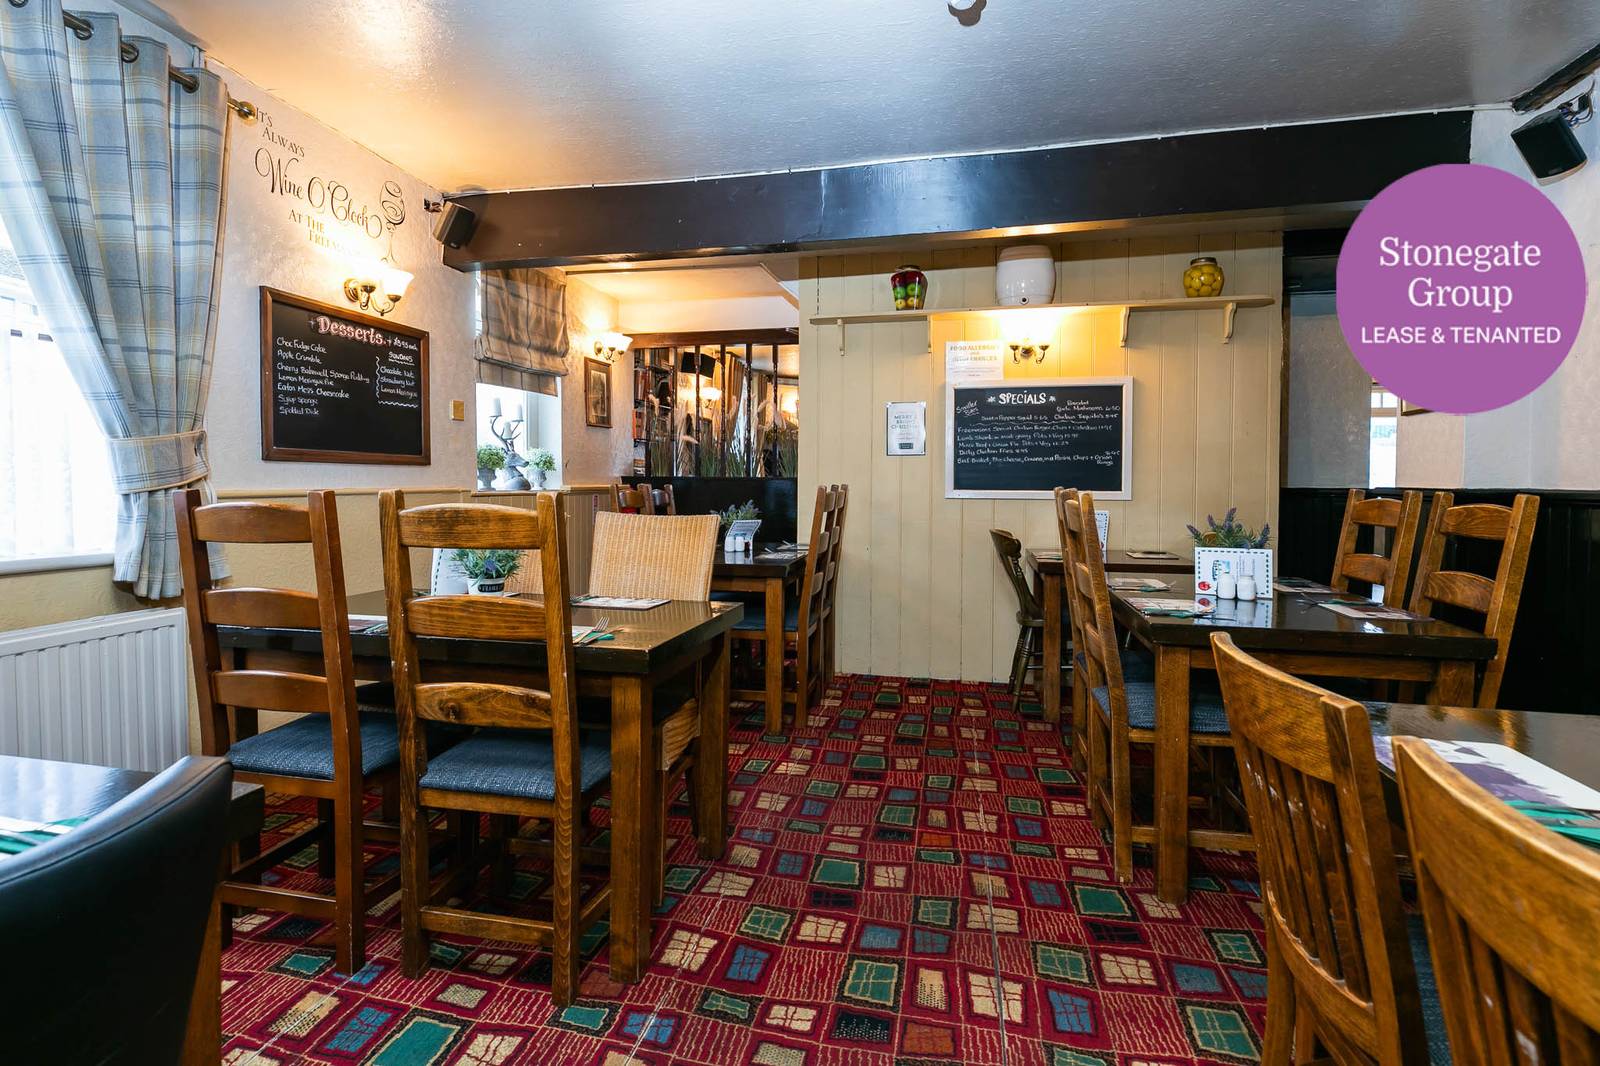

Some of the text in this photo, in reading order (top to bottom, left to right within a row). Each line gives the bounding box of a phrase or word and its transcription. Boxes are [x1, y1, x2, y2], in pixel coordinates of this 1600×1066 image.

[256, 107, 273, 127] IT'S
[262, 127, 305, 157] ALWAYS
[255, 147, 304, 200] Wine
[288, 209, 304, 224] AT
[277, 337, 328, 353] Choc Fudge Cake
[277, 349, 323, 365] Apple Crumble
[276, 362, 299, 374] Cherry
[350, 371, 370, 384] Pudding
[278, 372, 298, 382] Lemon
[297, 385, 315, 394] Mess
[315, 388, 351, 399] Cheesecake
[381, 384, 396, 395] Lemon
[278, 406, 304, 416] Spotted
